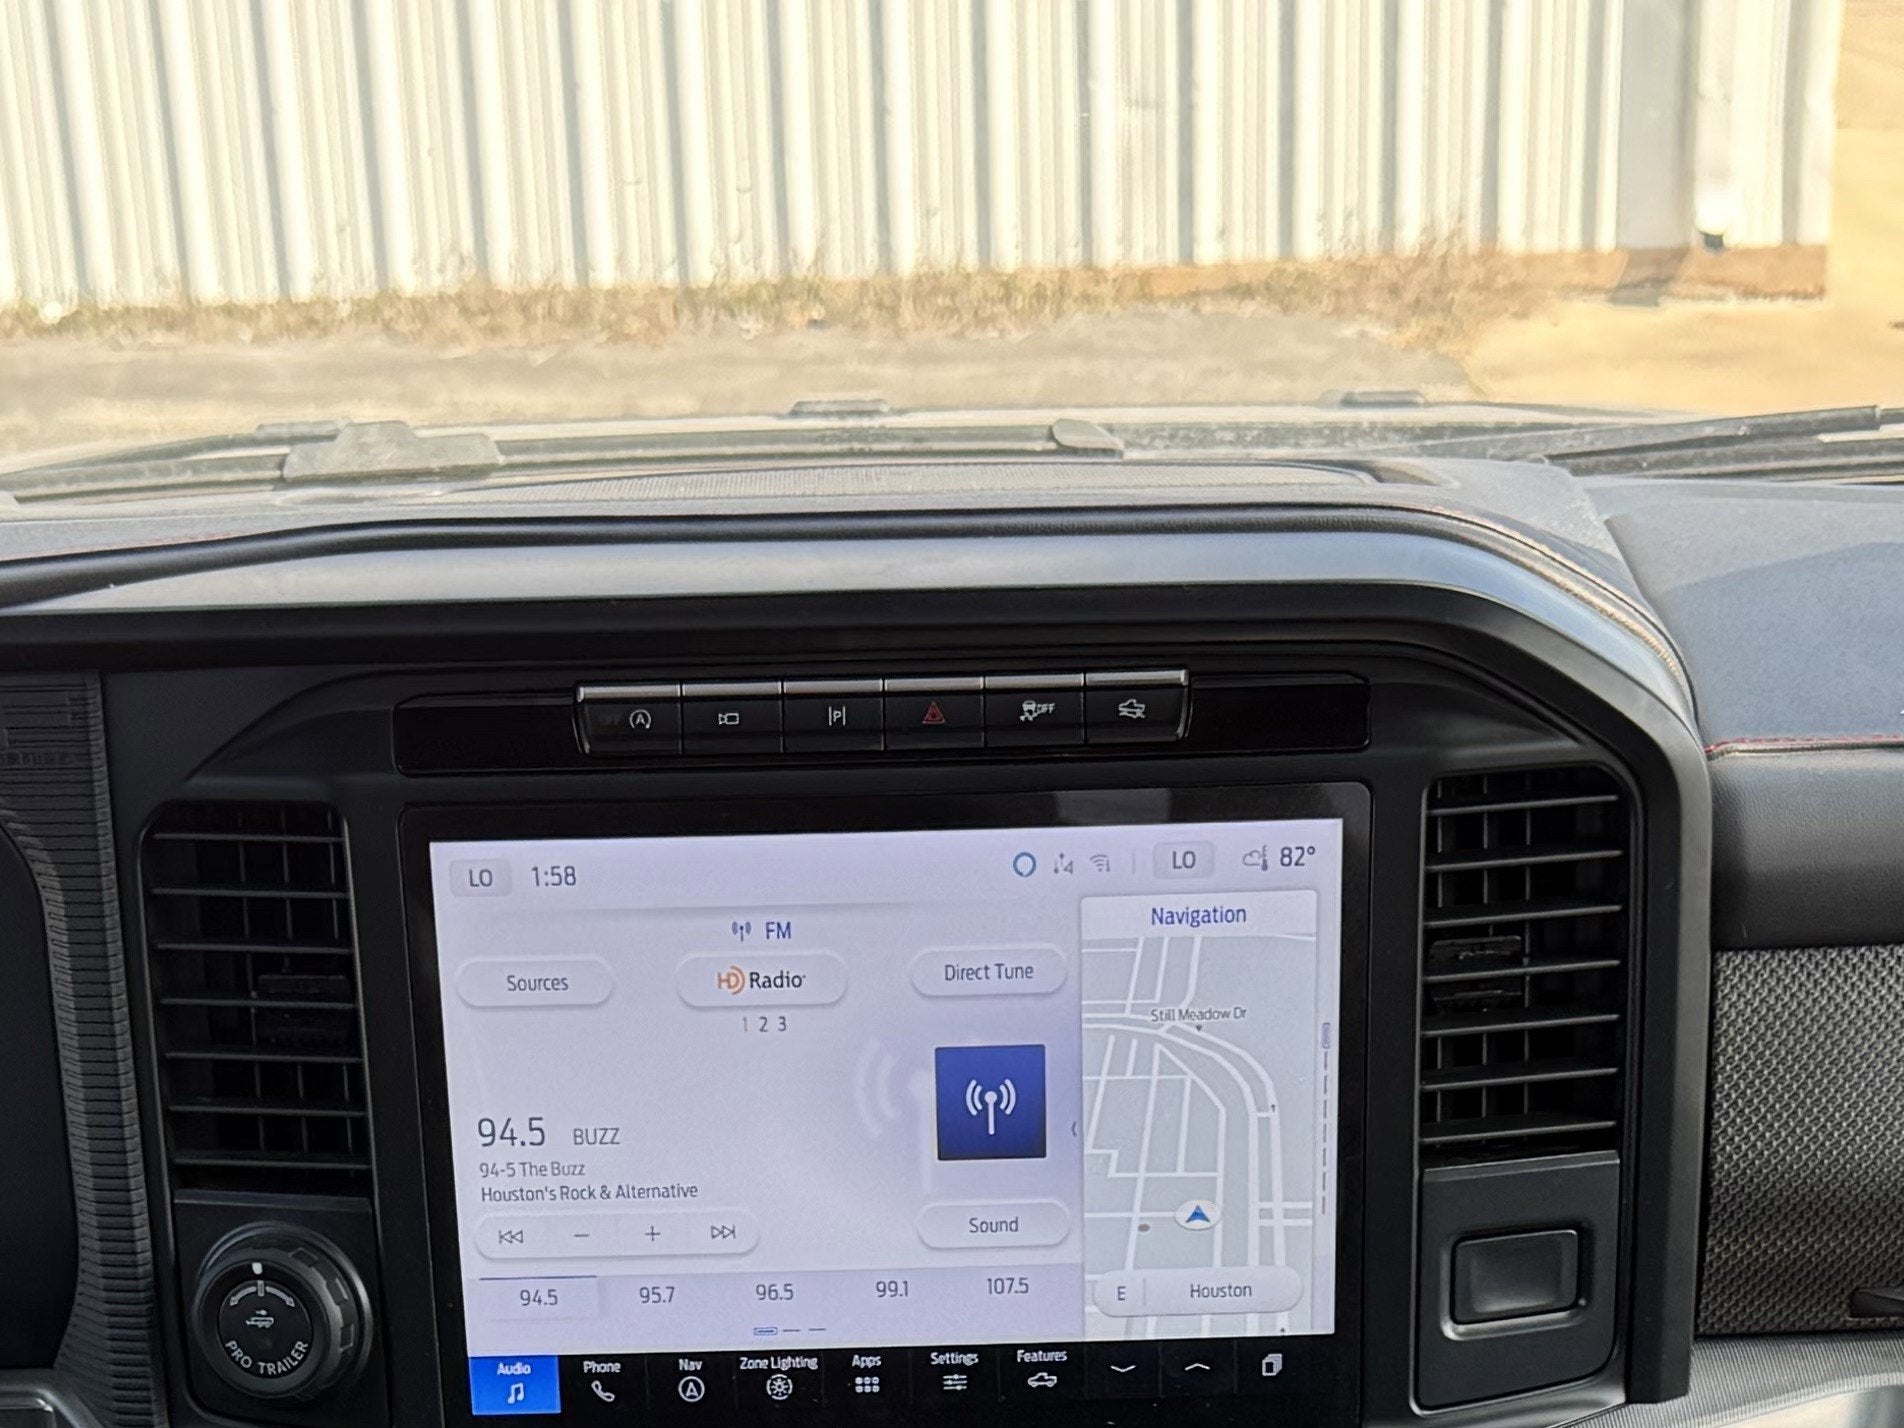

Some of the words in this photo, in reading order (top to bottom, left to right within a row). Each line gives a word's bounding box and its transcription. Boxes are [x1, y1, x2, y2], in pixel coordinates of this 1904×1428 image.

[1172, 850, 1196, 870] LO
[468, 868, 493, 888] LO
[531, 865, 577, 887] 1:58
[1151, 905, 1247, 928] Navigation
[765, 921, 792, 940] FM
[749, 969, 804, 990] Radio
[944, 962, 990, 982] Direct
[994, 962, 1034, 980] Tune
[506, 974, 569, 992] Sources
[1150, 1007, 1175, 1022] Still
[1178, 1007, 1231, 1022] Meadow
[1234, 1006, 1247, 1020] Dr
[759, 1017, 769, 1032] 2
[778, 1017, 787, 1032] 3
[477, 1117, 546, 1147] 94.5
[573, 1127, 621, 1145] BUZZ
[479, 1162, 516, 1178] 94-5
[519, 1161, 547, 1177] The
[551, 1161, 586, 1176] Buzz
[481, 1185, 557, 1203] Houston's
[560, 1184, 596, 1200] Rock
[600, 1185, 611, 1199] &
[615, 1183, 698, 1199] Alternative
[969, 1217, 1019, 1233] Sound
[520, 1289, 558, 1306] 94.5
[639, 1286, 675, 1304] 95.7
[756, 1283, 794, 1300] 96.5
[876, 1280, 909, 1297] 99.1
[987, 1277, 1029, 1295] 107.5
[1117, 1286, 1126, 1301] E
[1190, 1284, 1252, 1299] Houston
[225, 1341, 252, 1369] PRO
[258, 1341, 309, 1375] TRAILER
[678, 1359, 703, 1371] Nav
[740, 1357, 768, 1370] Zone
[770, 1355, 818, 1371] Lighting
[852, 1354, 882, 1368] Apps
[930, 1352, 979, 1366] Settings
[1016, 1350, 1068, 1363] Features
[497, 1361, 531, 1376] Audio
[583, 1360, 621, 1373] Phone
